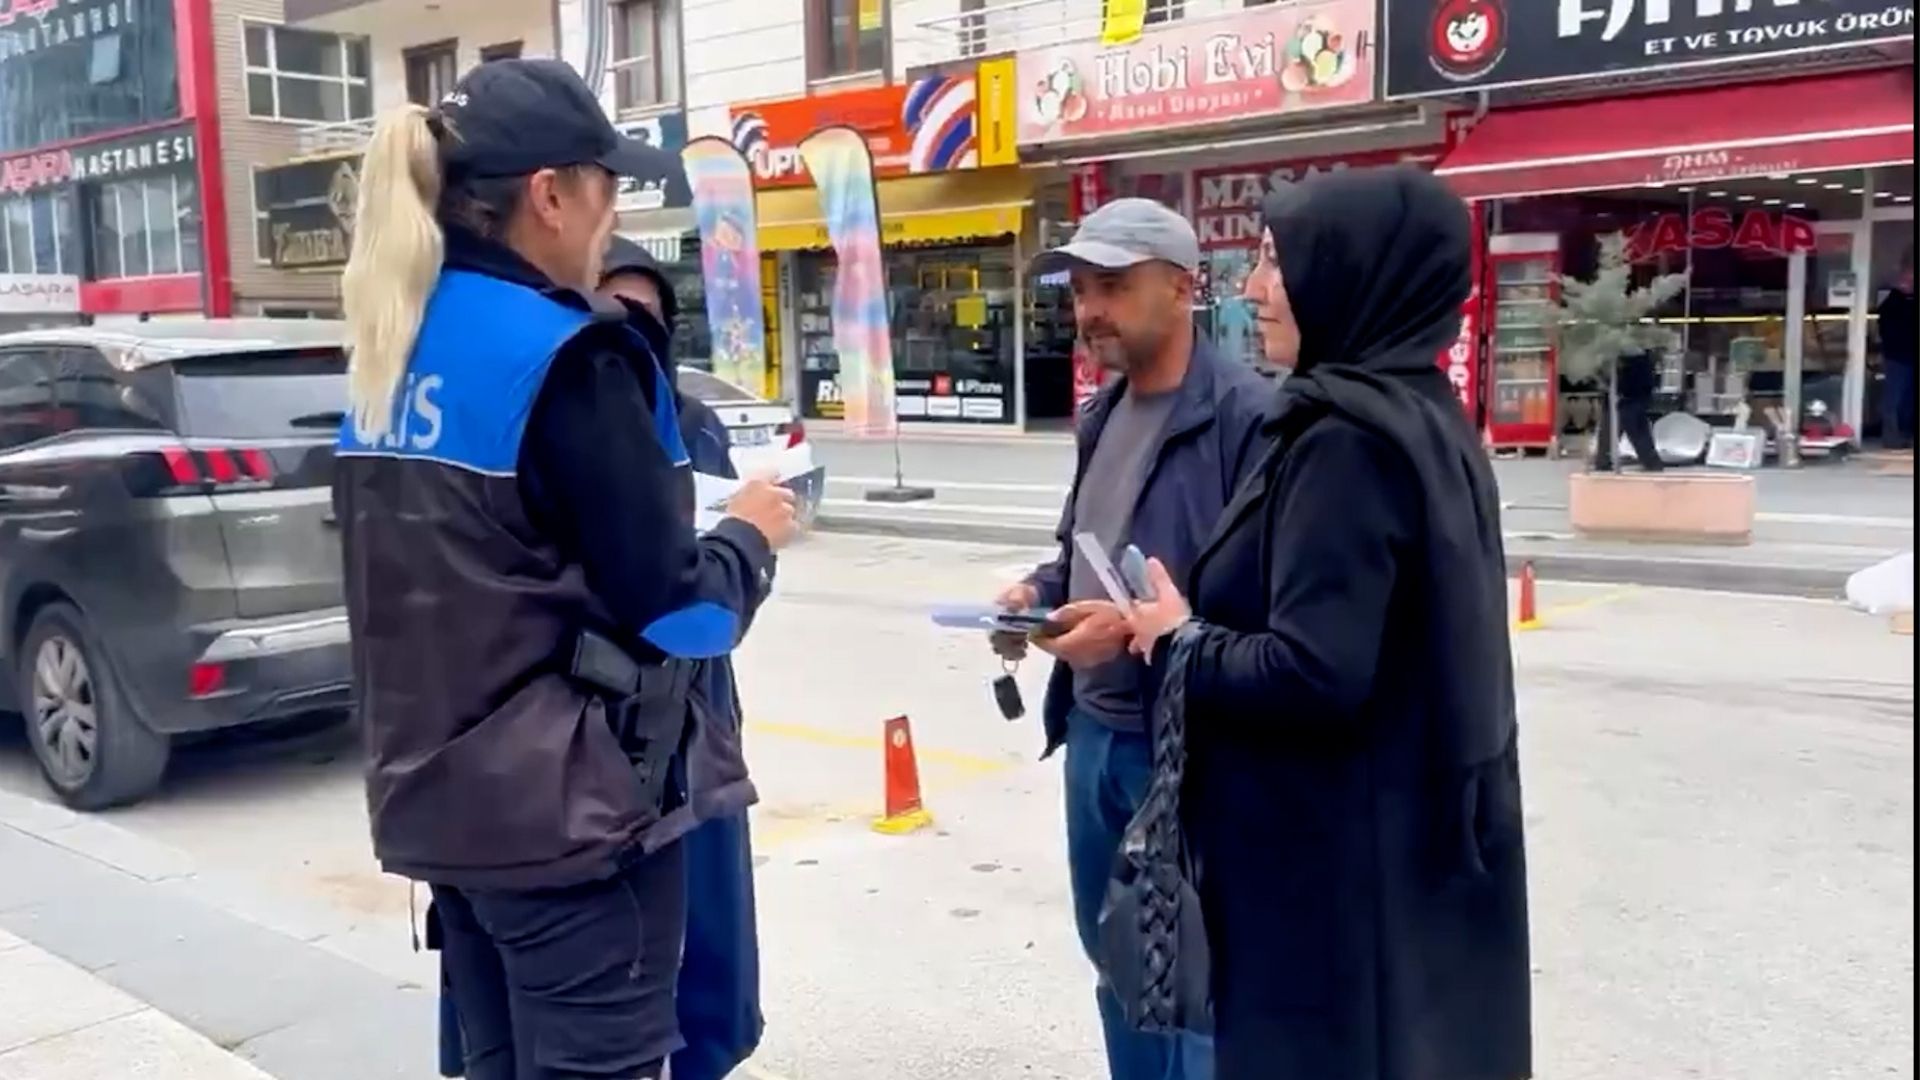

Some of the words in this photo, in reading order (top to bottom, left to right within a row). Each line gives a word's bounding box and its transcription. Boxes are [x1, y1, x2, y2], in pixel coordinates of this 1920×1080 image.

[1644, 37, 1677, 56] ET
[1684, 32, 1718, 51] VE
[1726, 19, 1828, 45] TAVUK
[1095, 44, 1193, 100] Hobi
[1205, 31, 1277, 84] Evi
[1198, 211, 1263, 242] KIN
